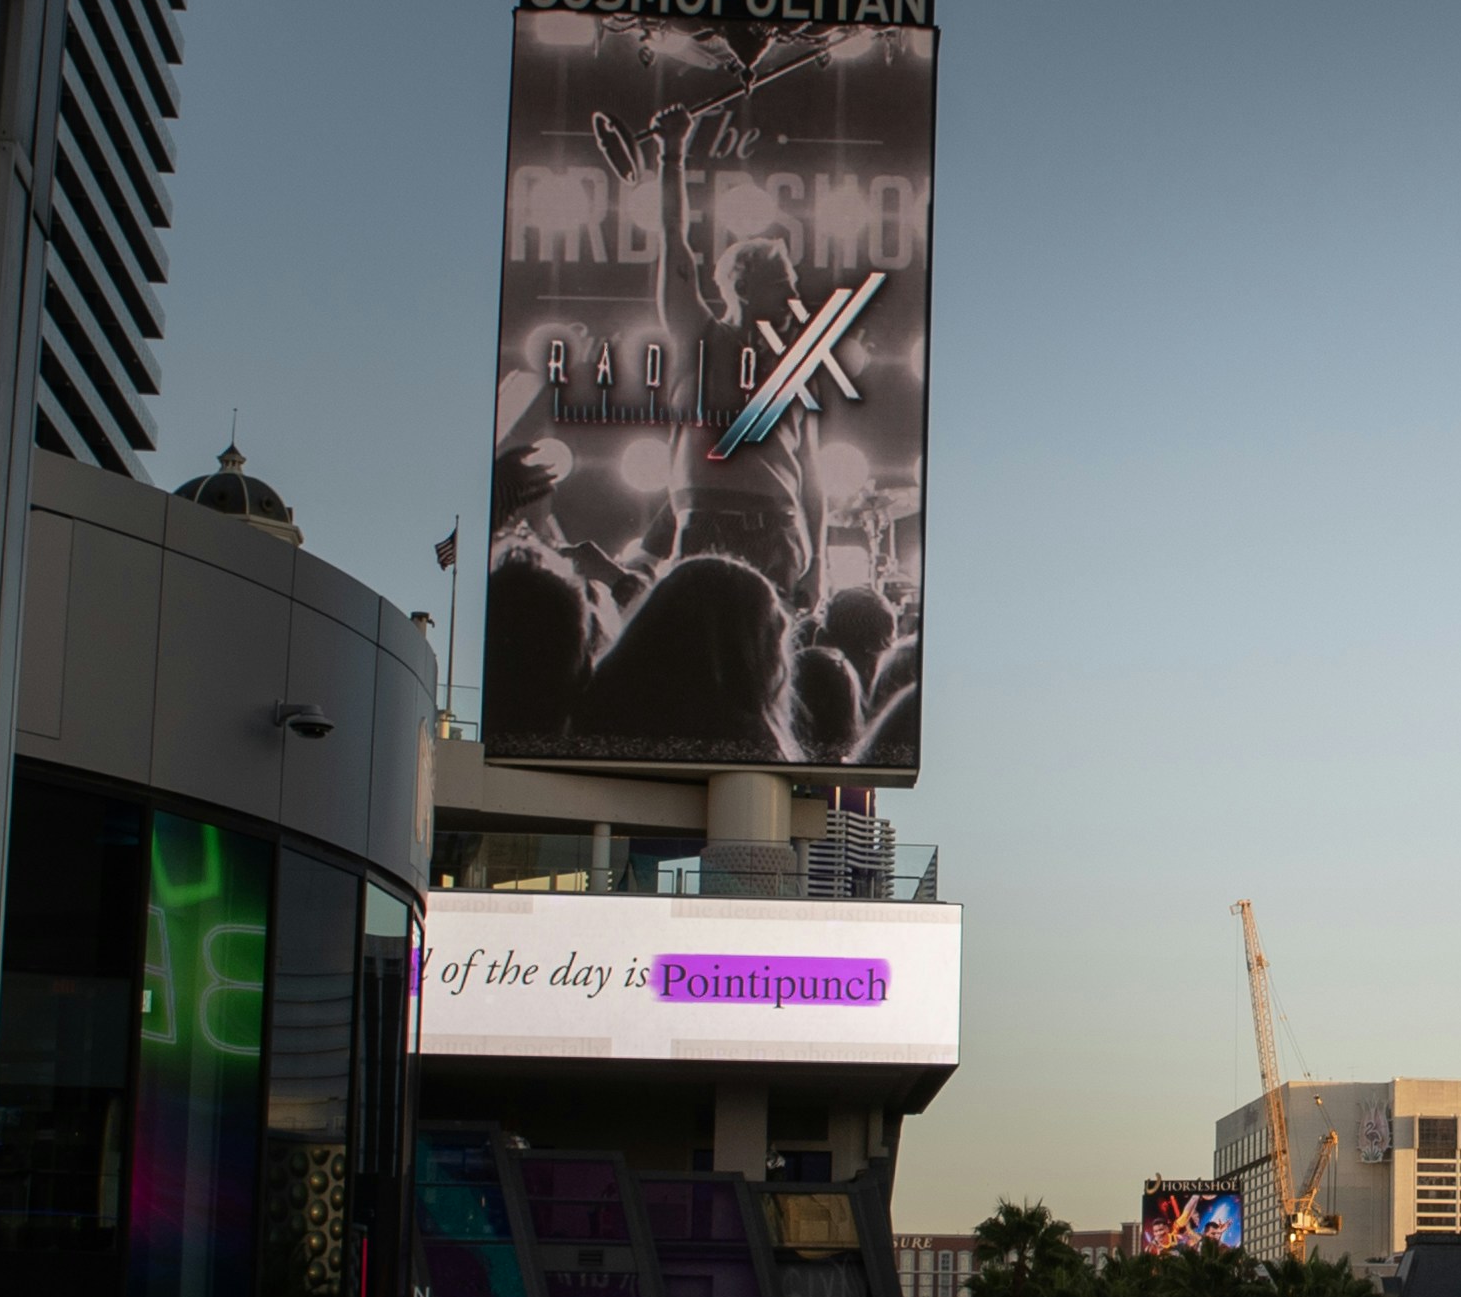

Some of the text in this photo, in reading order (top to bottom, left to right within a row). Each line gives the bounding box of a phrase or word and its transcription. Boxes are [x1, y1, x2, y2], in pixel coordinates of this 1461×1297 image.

[441, 949, 484, 995] of
[485, 950, 539, 985] the
[549, 951, 612, 998] day
[623, 957, 651, 988] is
[660, 963, 888, 1008] Pointipunch
[1162, 1180, 1239, 1192] HORSESHOE
